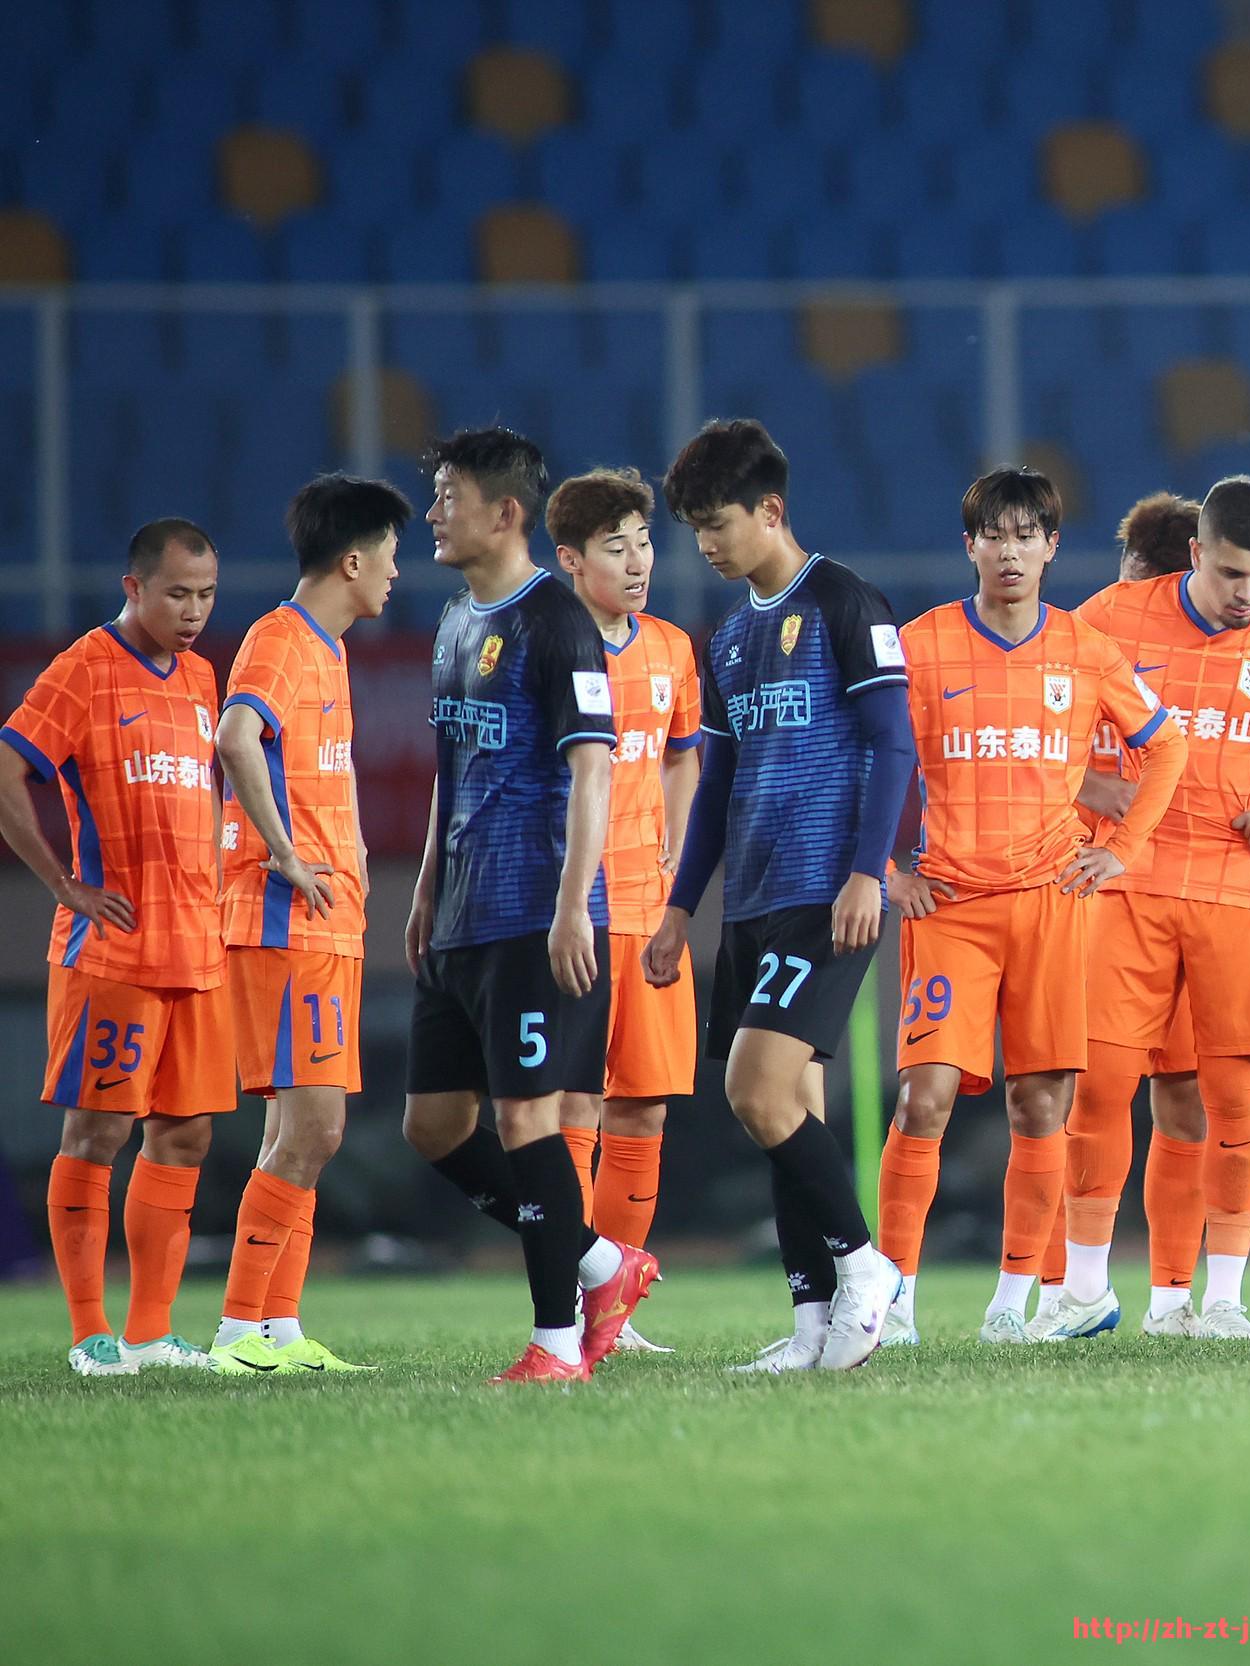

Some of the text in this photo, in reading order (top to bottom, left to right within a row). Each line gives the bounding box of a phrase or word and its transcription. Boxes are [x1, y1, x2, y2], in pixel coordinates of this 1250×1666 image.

[609, 727, 664, 764] 泰山
[943, 725, 1069, 763] 山东泰山
[750, 952, 812, 1009] 27
[90, 1019, 145, 1073] 35
[303, 994, 345, 1046] 11
[519, 1012, 547, 1068] 5
